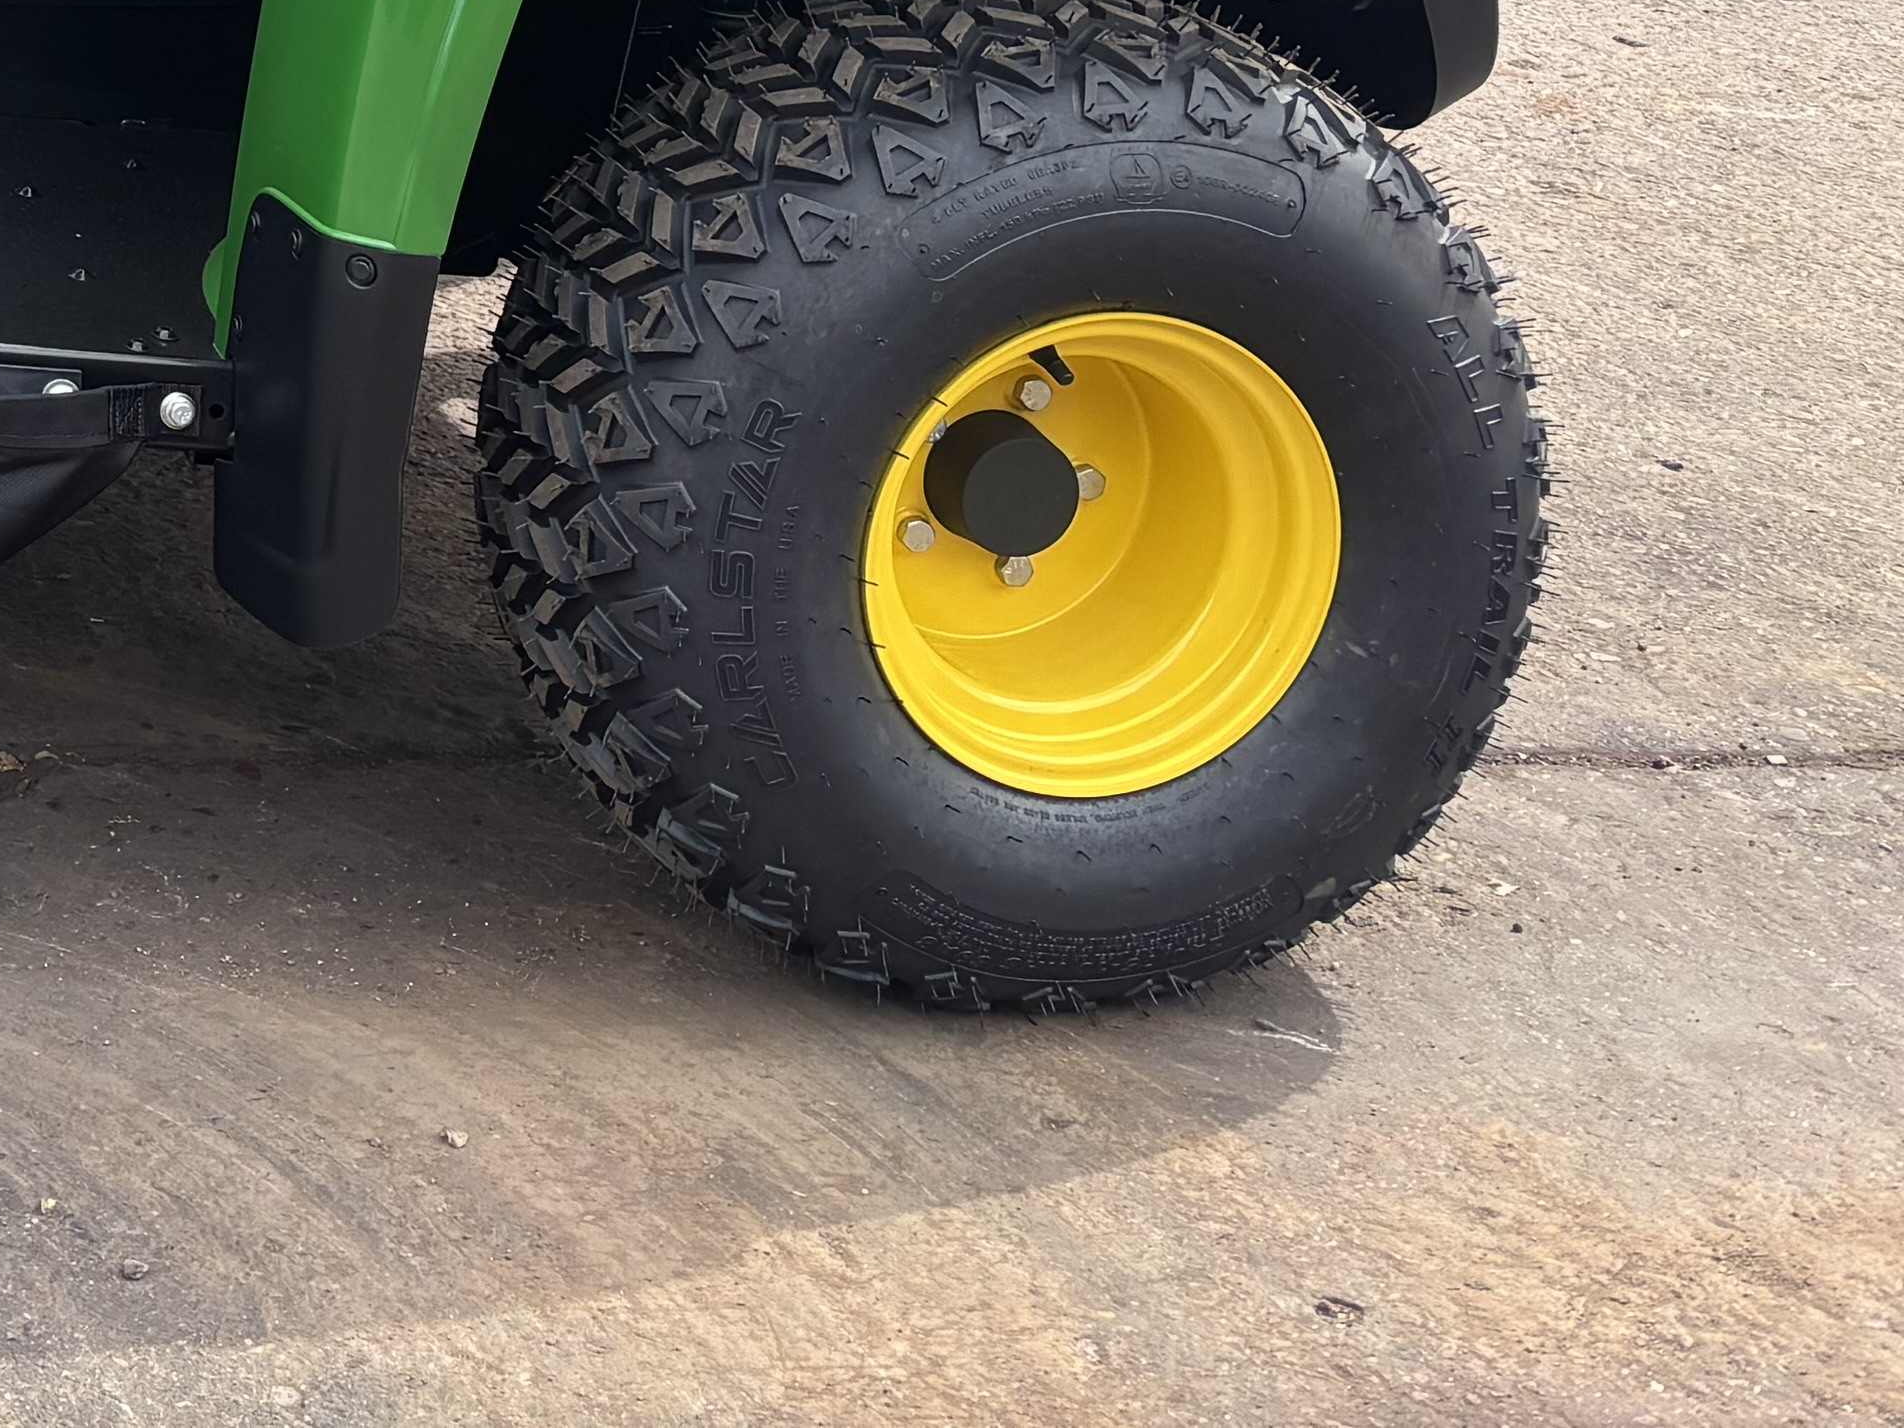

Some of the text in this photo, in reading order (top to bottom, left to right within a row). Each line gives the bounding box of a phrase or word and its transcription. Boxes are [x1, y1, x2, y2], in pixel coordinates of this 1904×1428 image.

[1426, 315, 1504, 450] ALL
[709, 397, 803, 786] CARLSTAR
[1460, 477, 1518, 695] TRAIL
